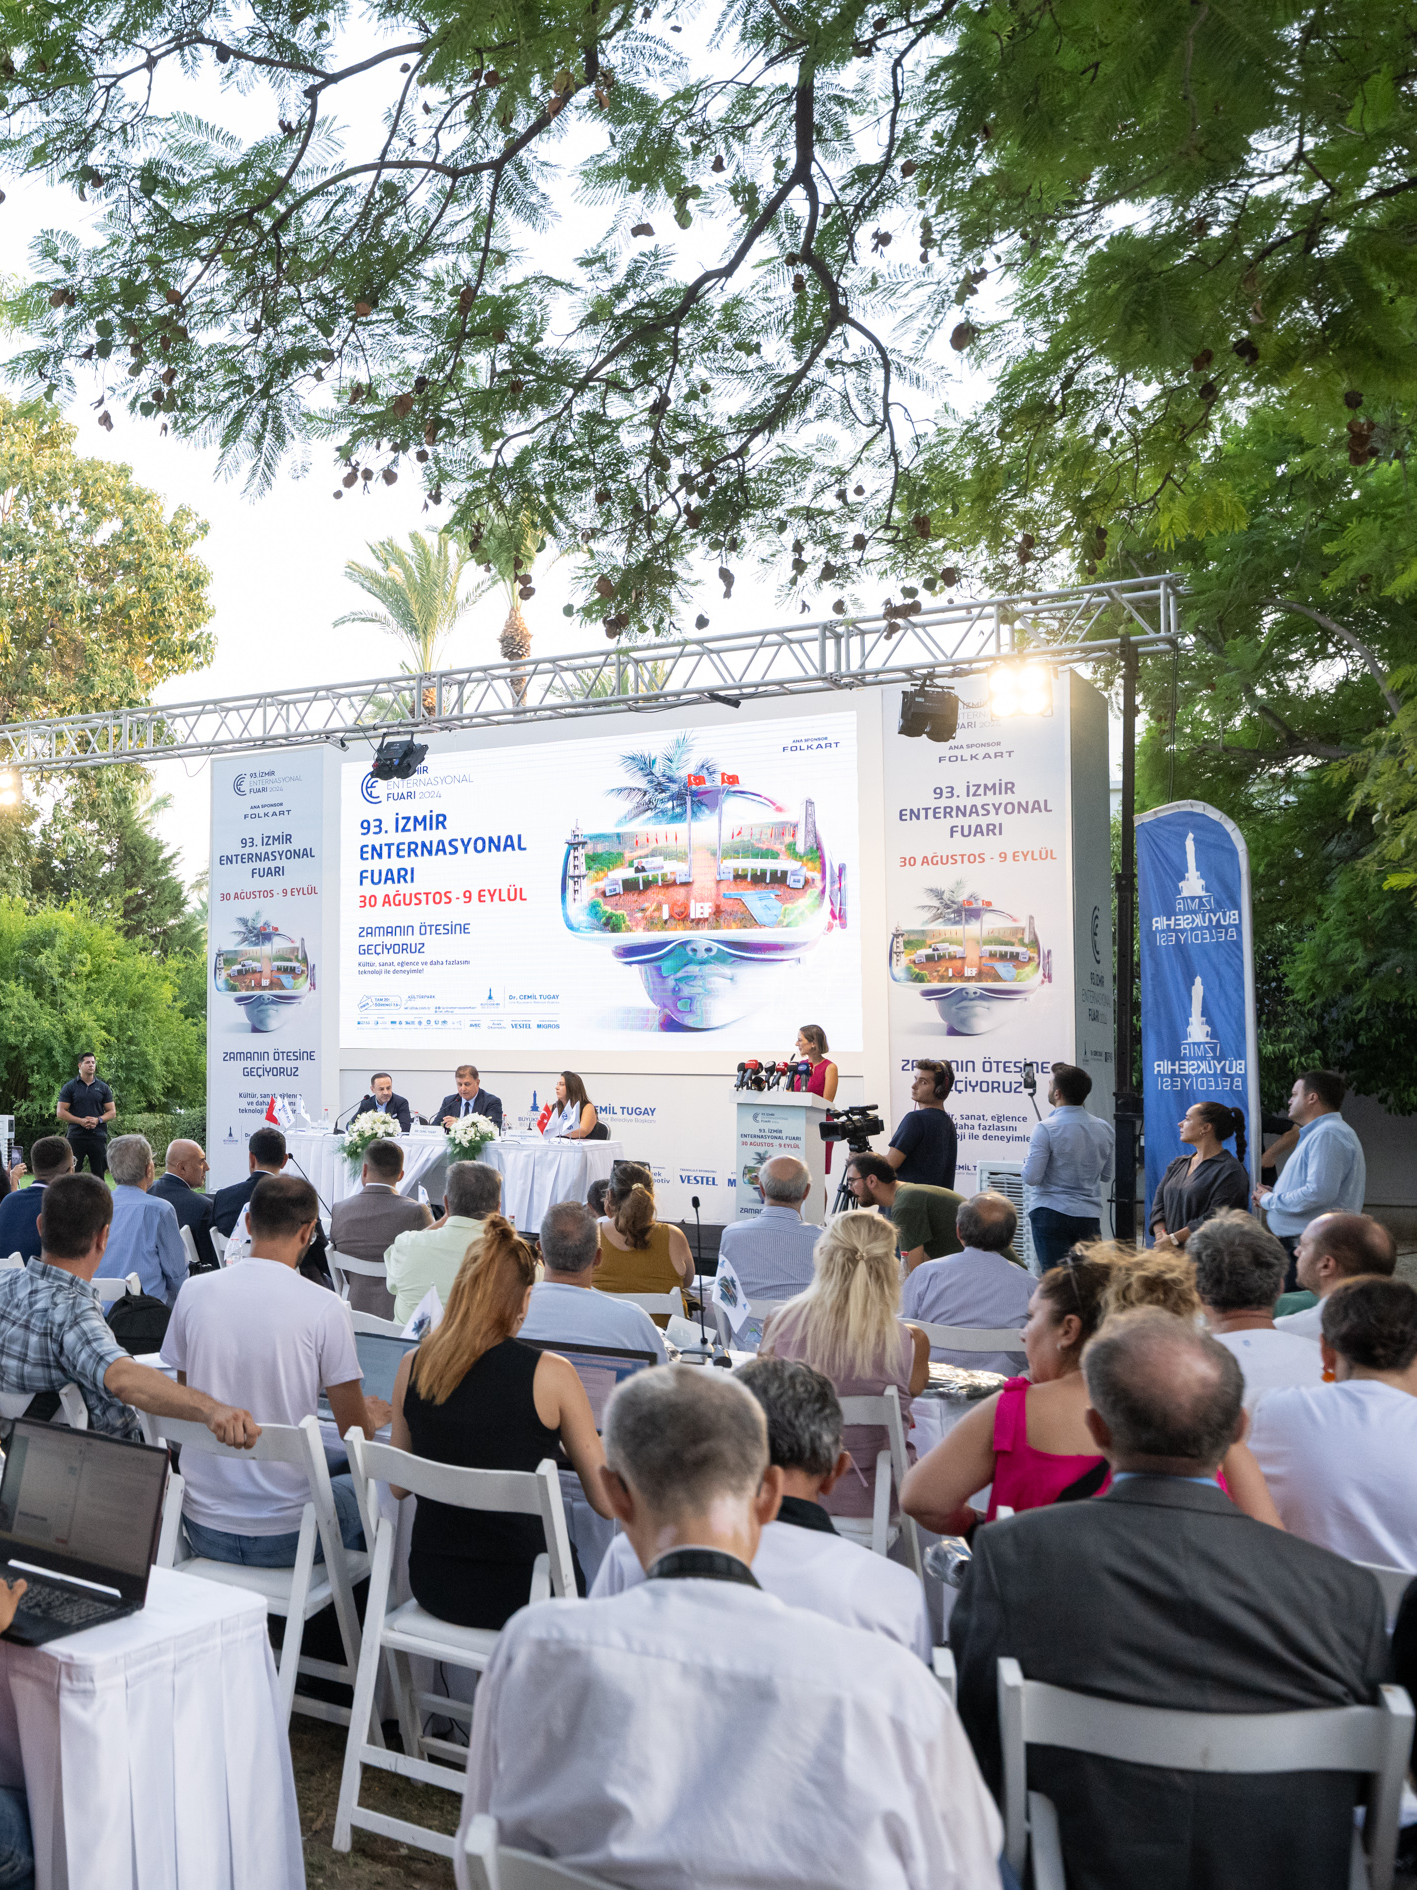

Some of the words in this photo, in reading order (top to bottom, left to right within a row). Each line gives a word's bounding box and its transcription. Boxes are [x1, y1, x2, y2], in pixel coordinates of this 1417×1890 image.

[956, 721, 976, 730] UARI
[782, 742, 840, 752] FOLKART
[965, 741, 1002, 749] SPONSOR
[938, 750, 1015, 764] FOLKART
[249, 775, 303, 787] ENTERNASYONAL
[386, 774, 474, 790] ENTERNASYONAL
[386, 791, 416, 802] FUARI
[419, 791, 442, 800] 2024
[933, 785, 960, 800] 93.
[966, 779, 1016, 797] İZMİR
[244, 809, 292, 820] FOLKART
[899, 799, 1053, 822] ENTERNASYONAL
[360, 818, 388, 836] 93.
[395, 810, 447, 833] İZMİR
[949, 822, 1003, 838] FUARI
[240, 837, 258, 849] 93.
[261, 832, 292, 847] İZMİR
[360, 834, 527, 861] ENTERNASYONAL
[219, 847, 315, 866] ENTERNASYONAL
[899, 856, 917, 868] 30
[921, 852, 986, 867] AĞUSTOS
[998, 851, 1008, 862] 9
[1012, 846, 1057, 862] EYLÜL
[251, 866, 285, 879] FUARI
[360, 867, 415, 886] FUARI
[220, 892, 231, 902] 30
[233, 889, 274, 901] AĞUSTOS
[282, 888, 288, 897] 9
[290, 884, 318, 896] EYLÜL
[359, 894, 378, 908] 30
[382, 890, 452, 907] AĞUSTOS
[463, 890, 472, 904] 9
[478, 884, 527, 903] EYLÜL
[358, 925, 414, 938] ZAMANIN
[419, 921, 471, 936] ÖTESİNE
[358, 941, 425, 956] GEÇİYORUZ
[397, 960, 419, 968] eğlence
[358, 968, 383, 976] teknoloji
[222, 1051, 270, 1062] ZAMANIN
[273, 1048, 316, 1061] ÖTESİNE
[242, 1064, 299, 1078] GEÇİYORUZ
[238, 1092, 259, 1100] Kültür,
[595, 1104, 617, 1115] EMİL
[620, 1106, 657, 1117] TUGAY
[960, 1113, 988, 1122] sanat,
[990, 1112, 1028, 1124] eğlence
[978, 1122, 1017, 1132] fazlasını
[968, 1132, 980, 1141] ile
[679, 1174, 718, 1187] VESTEL
